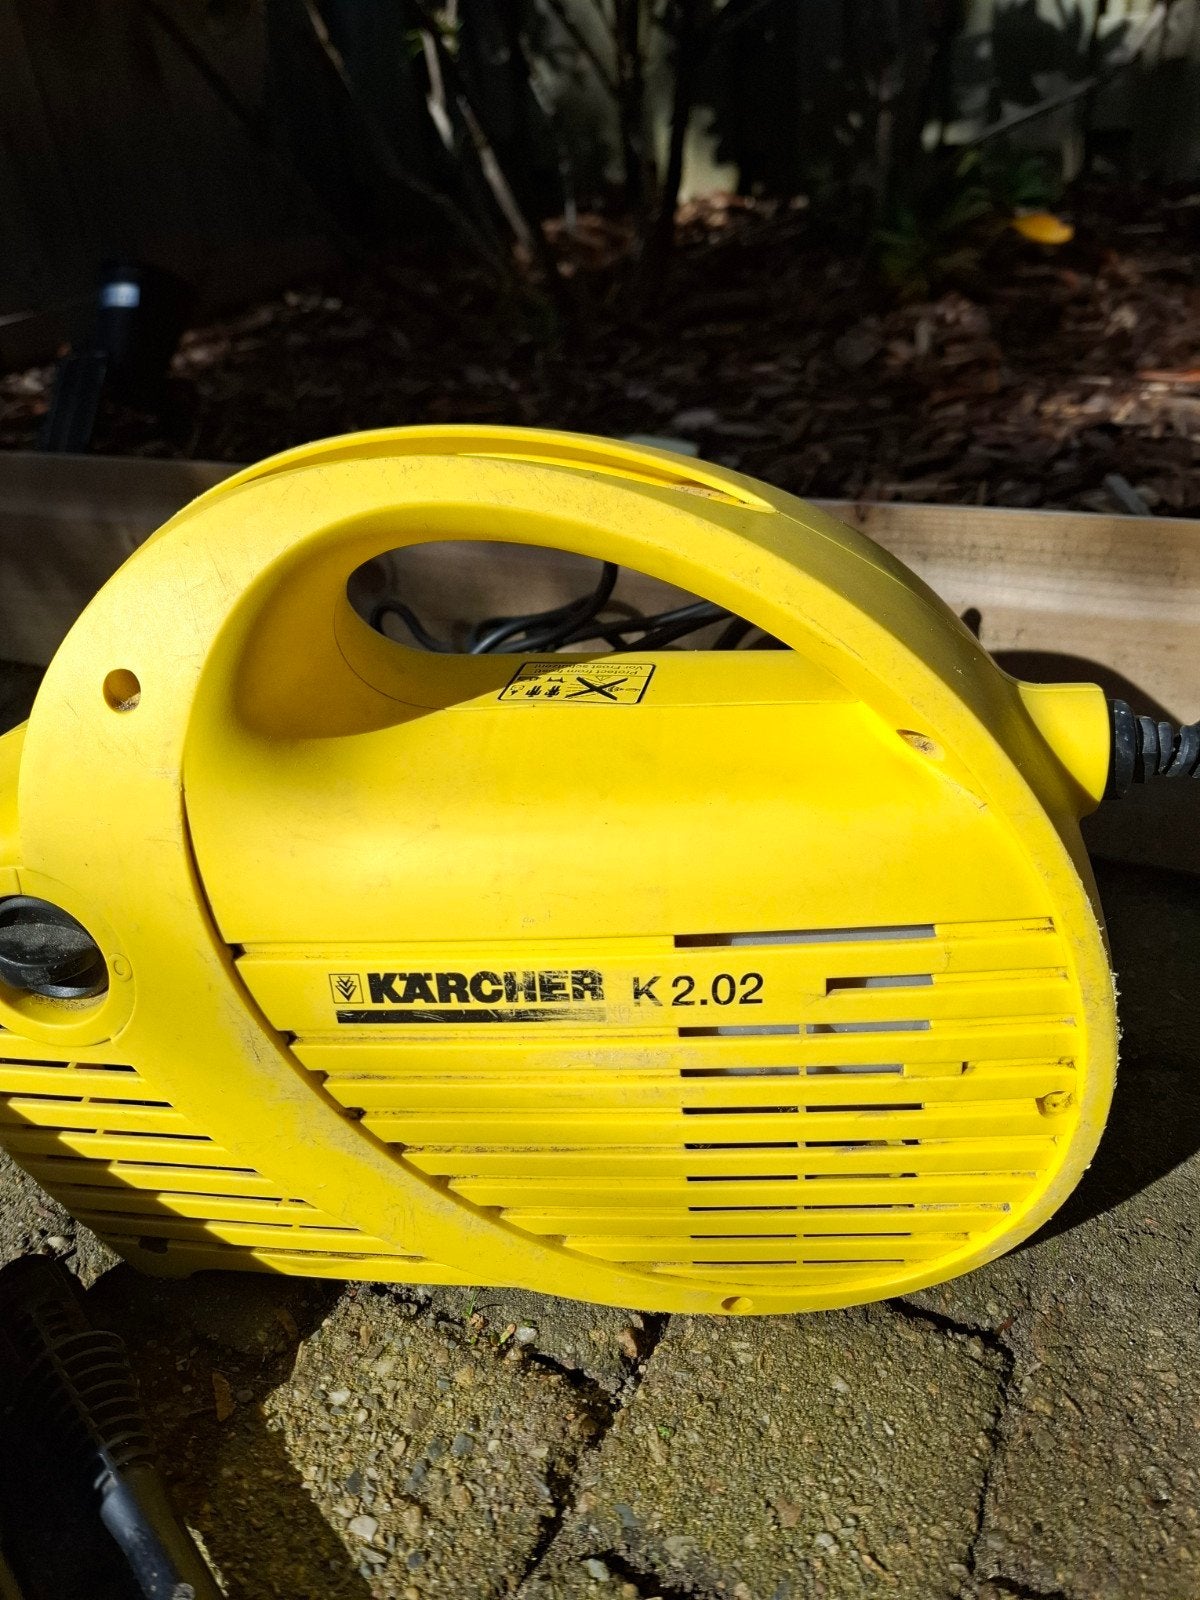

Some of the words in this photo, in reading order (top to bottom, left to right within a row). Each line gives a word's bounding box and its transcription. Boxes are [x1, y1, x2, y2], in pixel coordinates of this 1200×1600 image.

[367, 970, 605, 1004] KÄRCHER
[633, 975, 663, 1007] K
[671, 972, 764, 1006] 2.02
